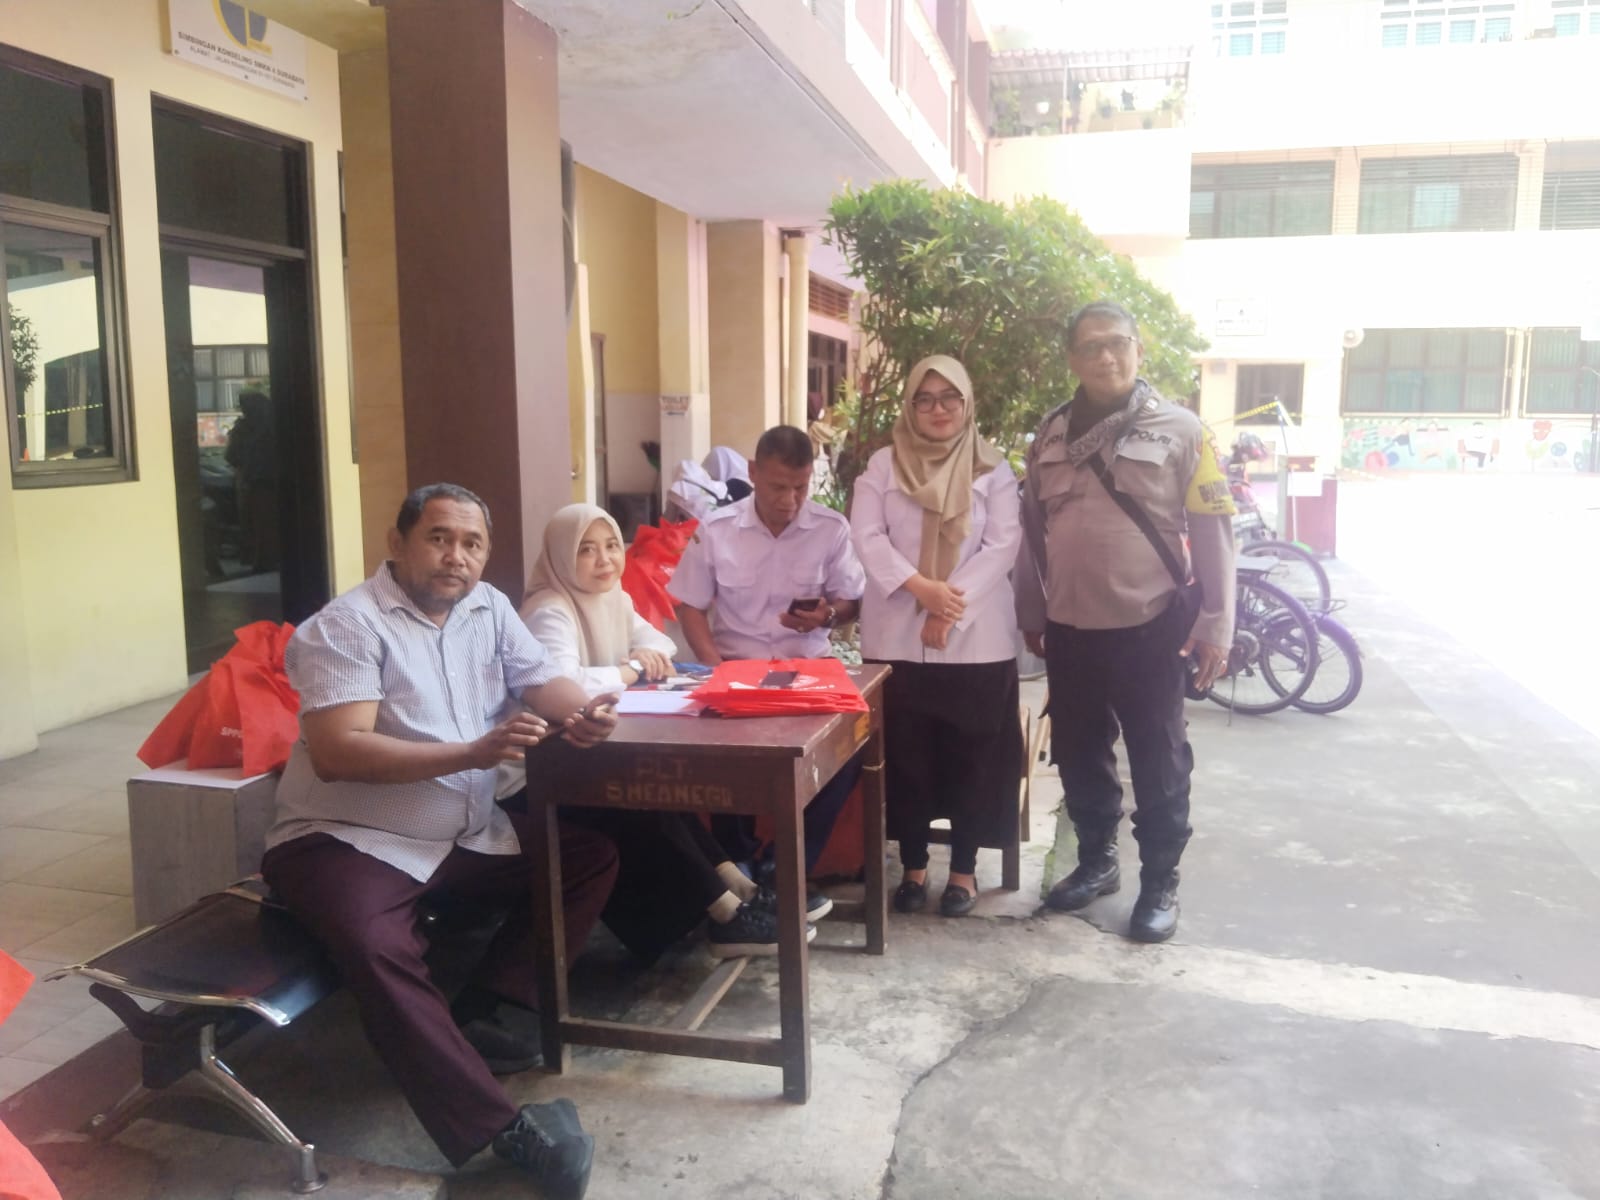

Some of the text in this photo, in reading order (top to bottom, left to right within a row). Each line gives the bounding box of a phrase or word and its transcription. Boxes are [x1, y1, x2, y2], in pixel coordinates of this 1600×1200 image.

[178, 31, 216, 52] BIMBINGAN
[217, 46, 253, 66] KONSELING
[277, 68, 305, 84] SURABAYA
[1129, 429, 1172, 445] POLRI
